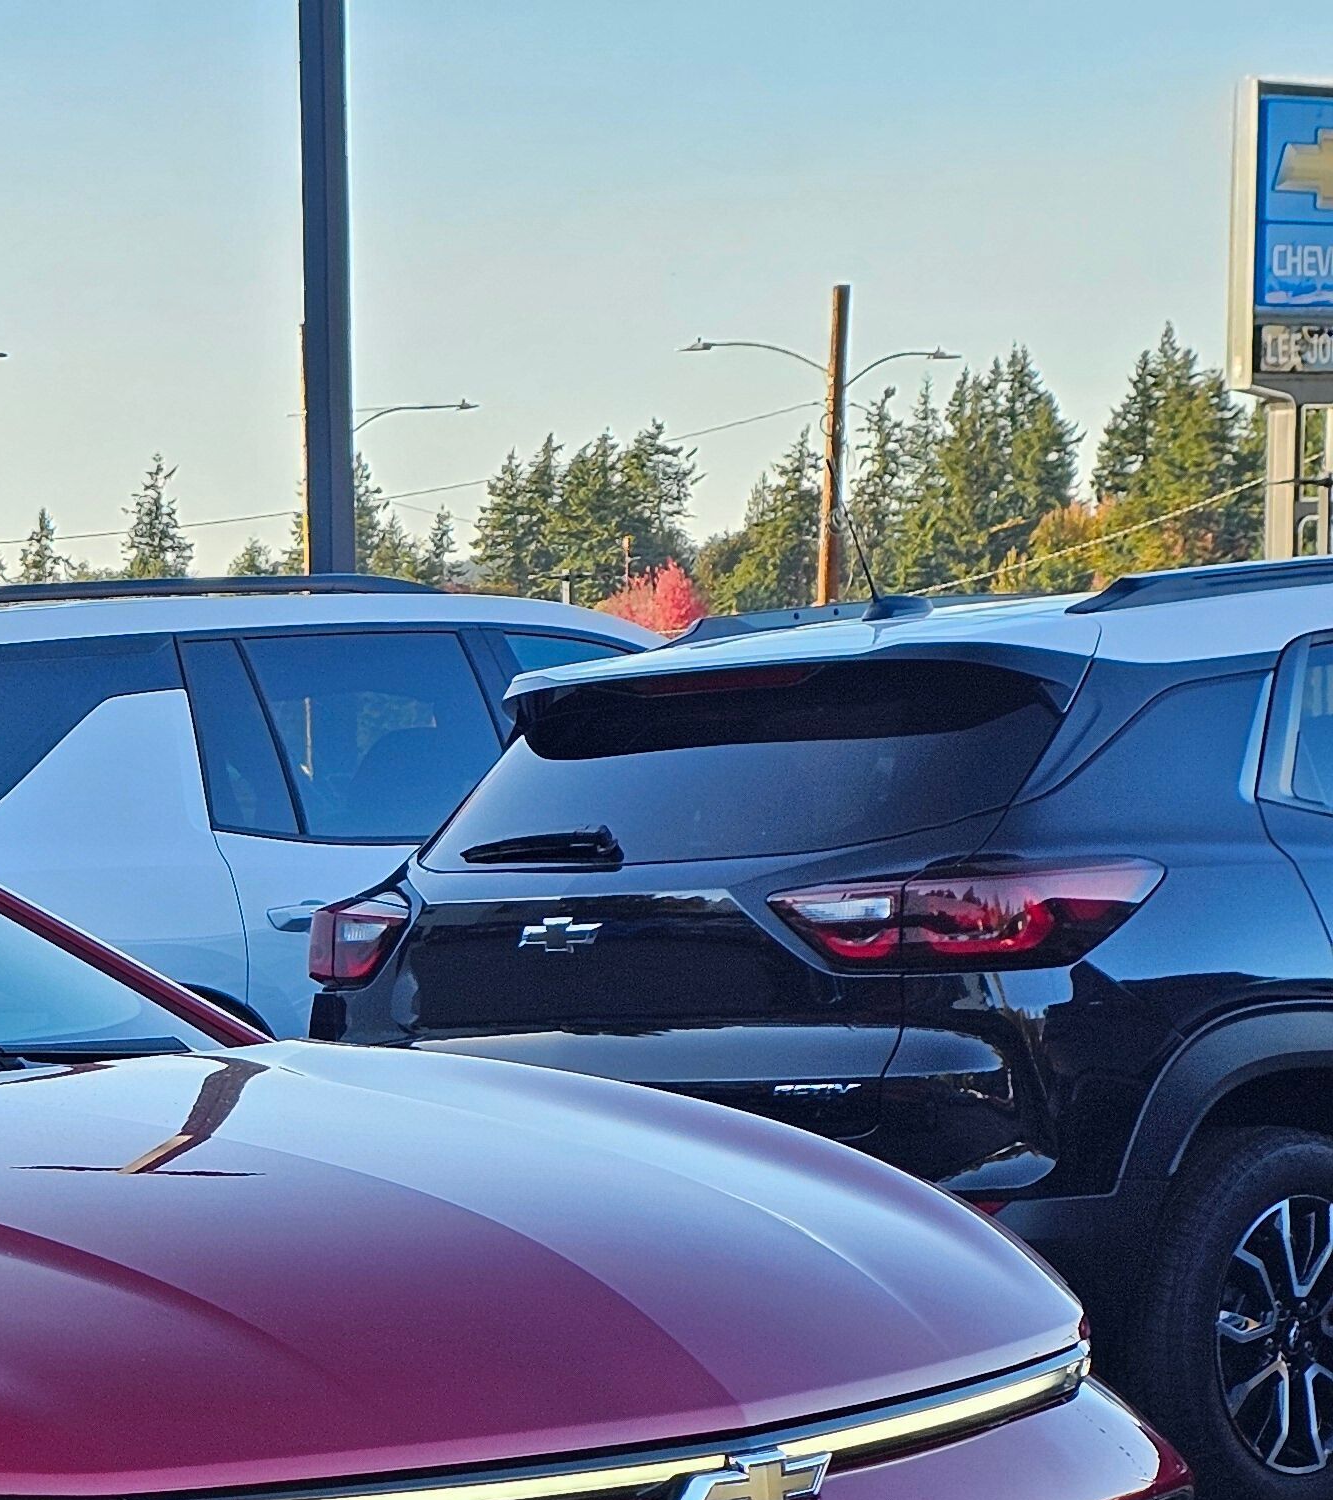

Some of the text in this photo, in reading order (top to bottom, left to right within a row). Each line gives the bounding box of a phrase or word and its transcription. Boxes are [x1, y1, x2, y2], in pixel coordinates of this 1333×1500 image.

[1273, 244, 1333, 277] CHEV
[1265, 332, 1333, 366] LEE JO
